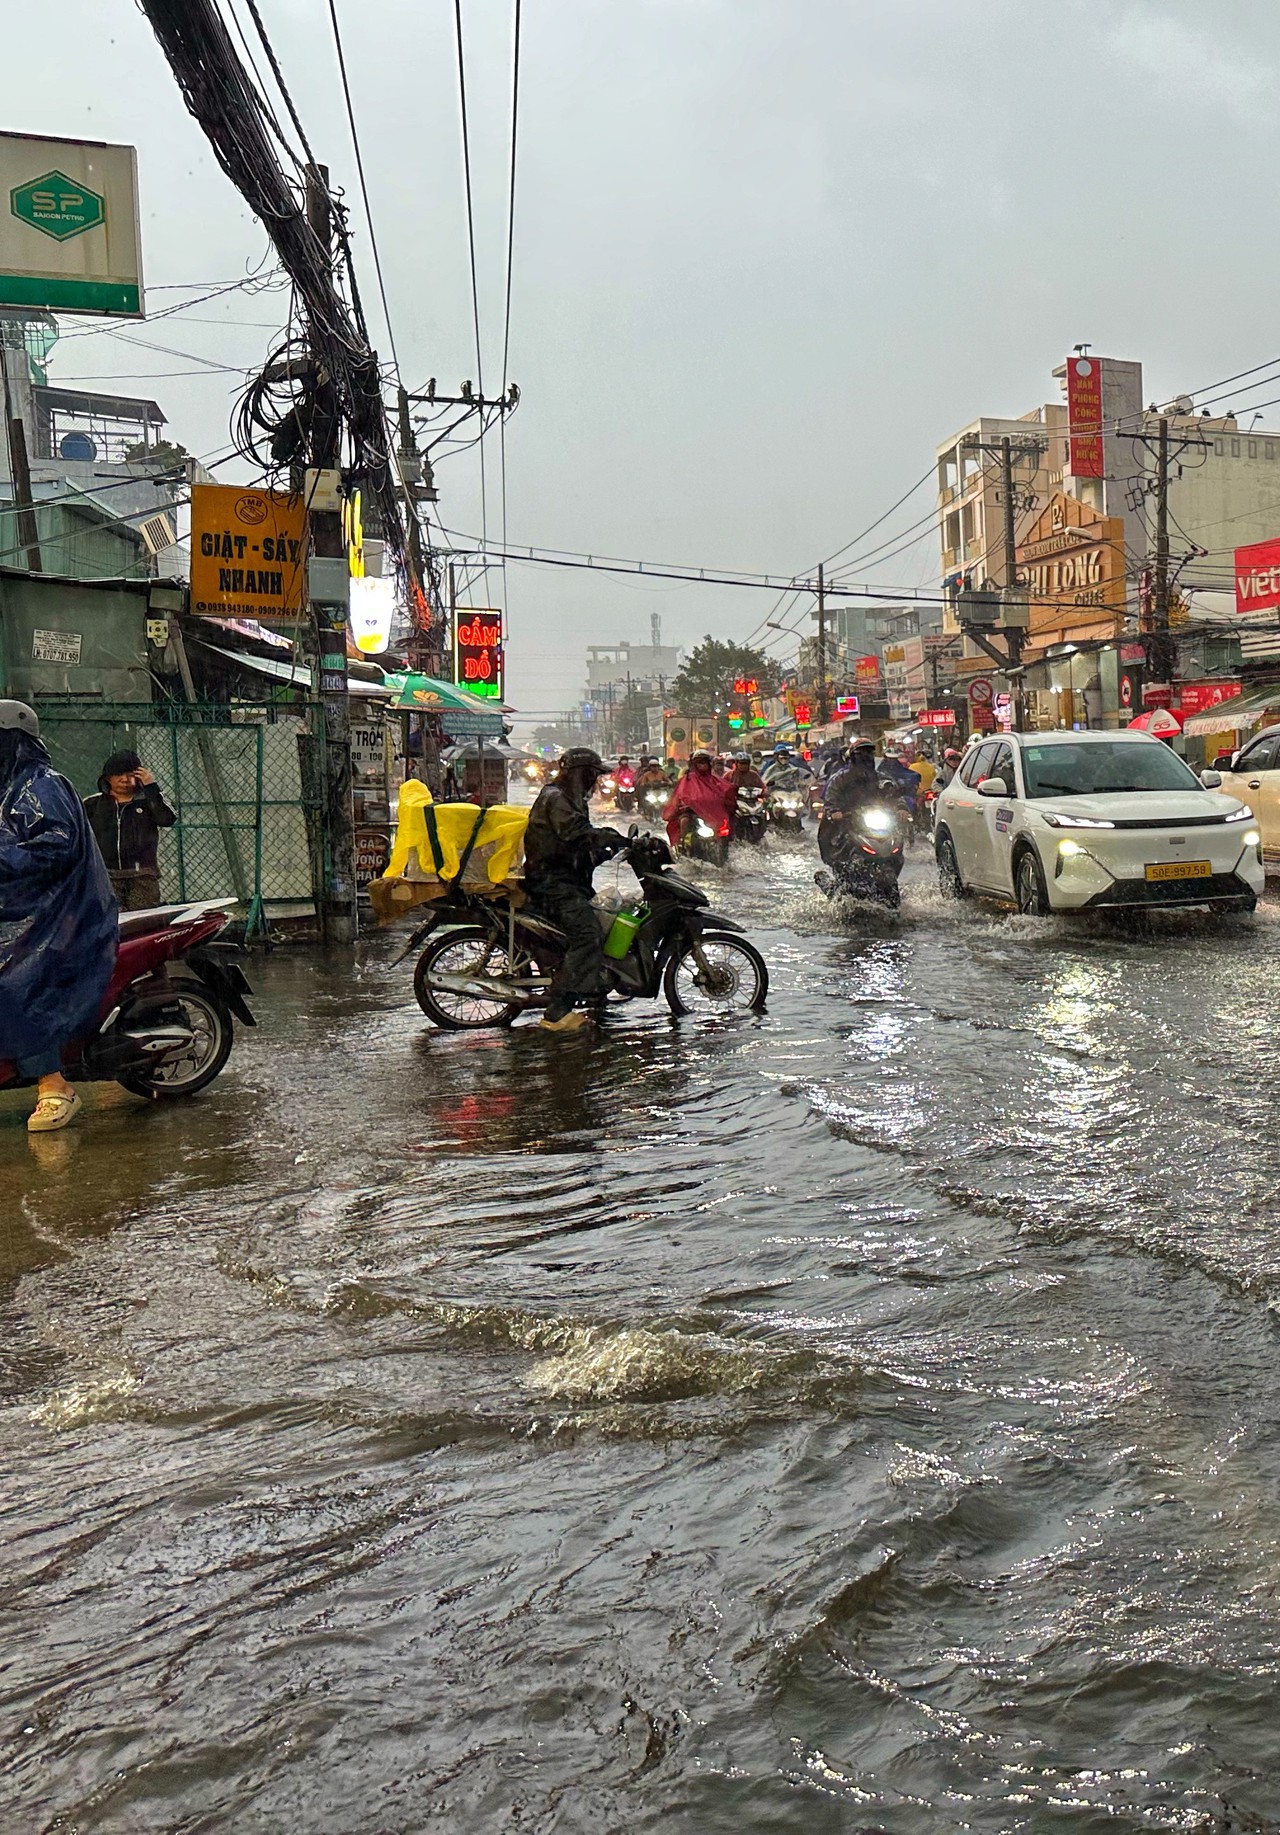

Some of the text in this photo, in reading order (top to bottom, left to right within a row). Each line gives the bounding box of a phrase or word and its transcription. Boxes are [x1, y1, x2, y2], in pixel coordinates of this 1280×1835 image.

[32, 191, 83, 211] SP
[33, 211, 85, 221] SAIGON PETRO
[241, 498, 263, 507] TMB
[201, 530, 302, 564] GIẶT SẤY
[219, 568, 283, 595] NHANH
[1053, 550, 1100, 594] LONG
